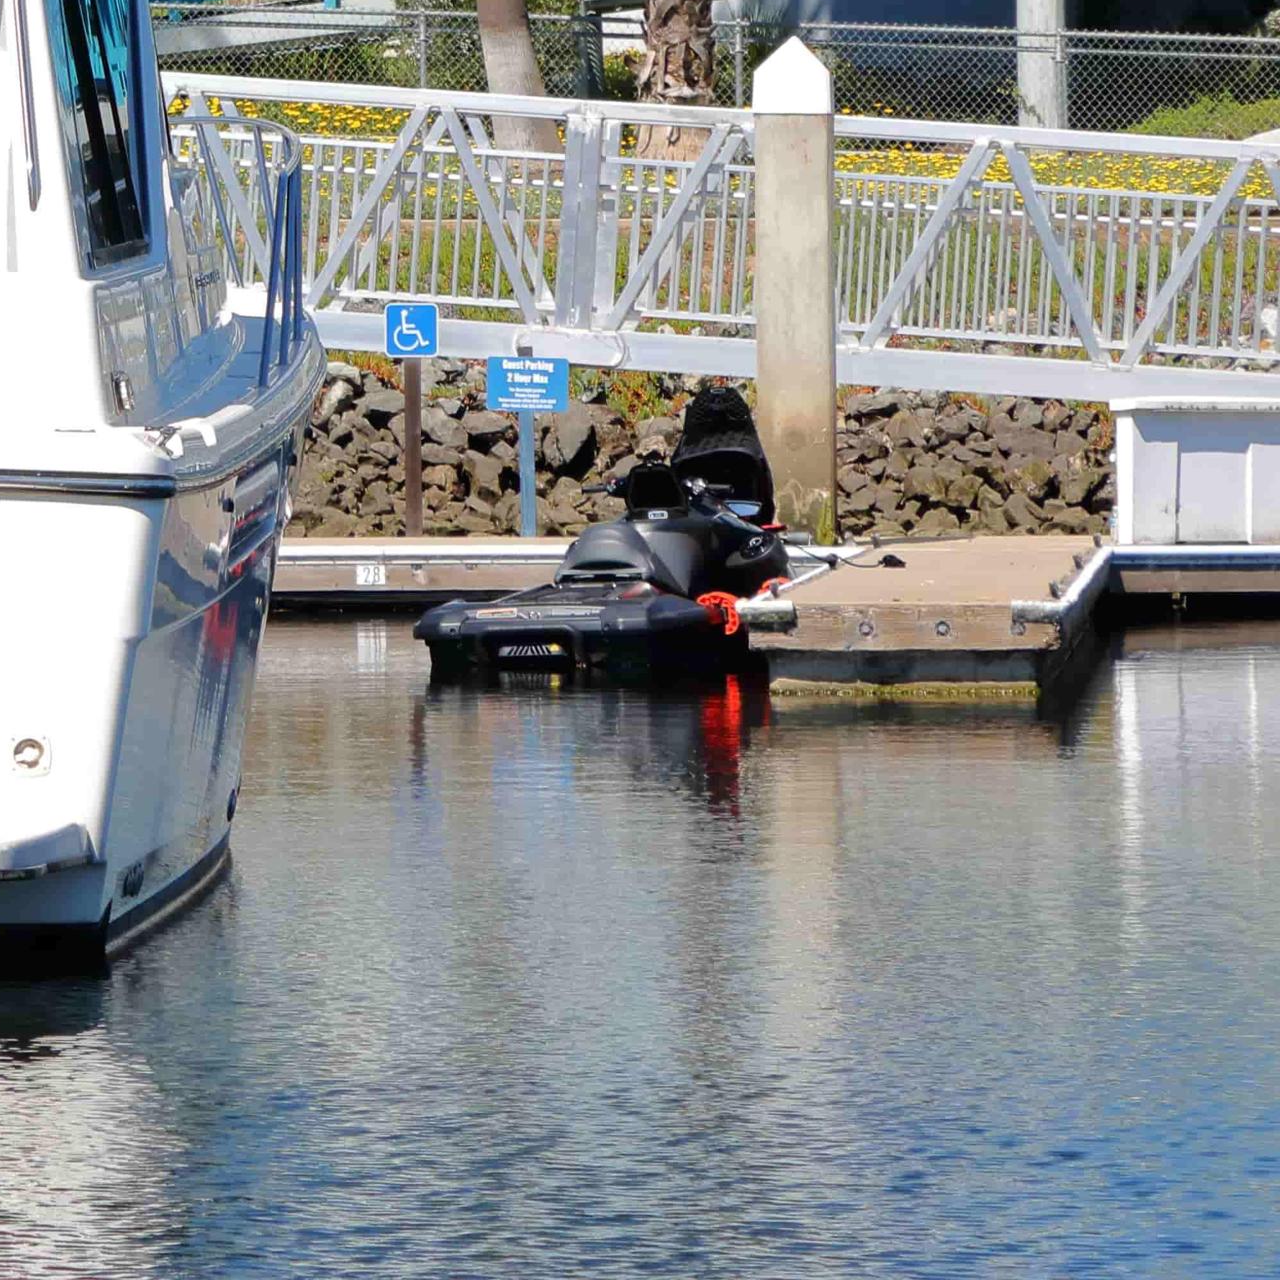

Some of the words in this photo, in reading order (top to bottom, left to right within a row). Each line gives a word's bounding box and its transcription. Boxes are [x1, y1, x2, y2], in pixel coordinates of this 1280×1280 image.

[502, 359, 524, 370] Guest
[525, 360, 554, 373] Parking
[507, 372, 513, 382] 2
[533, 373, 549, 384] Max
[363, 566, 380, 585] 28
